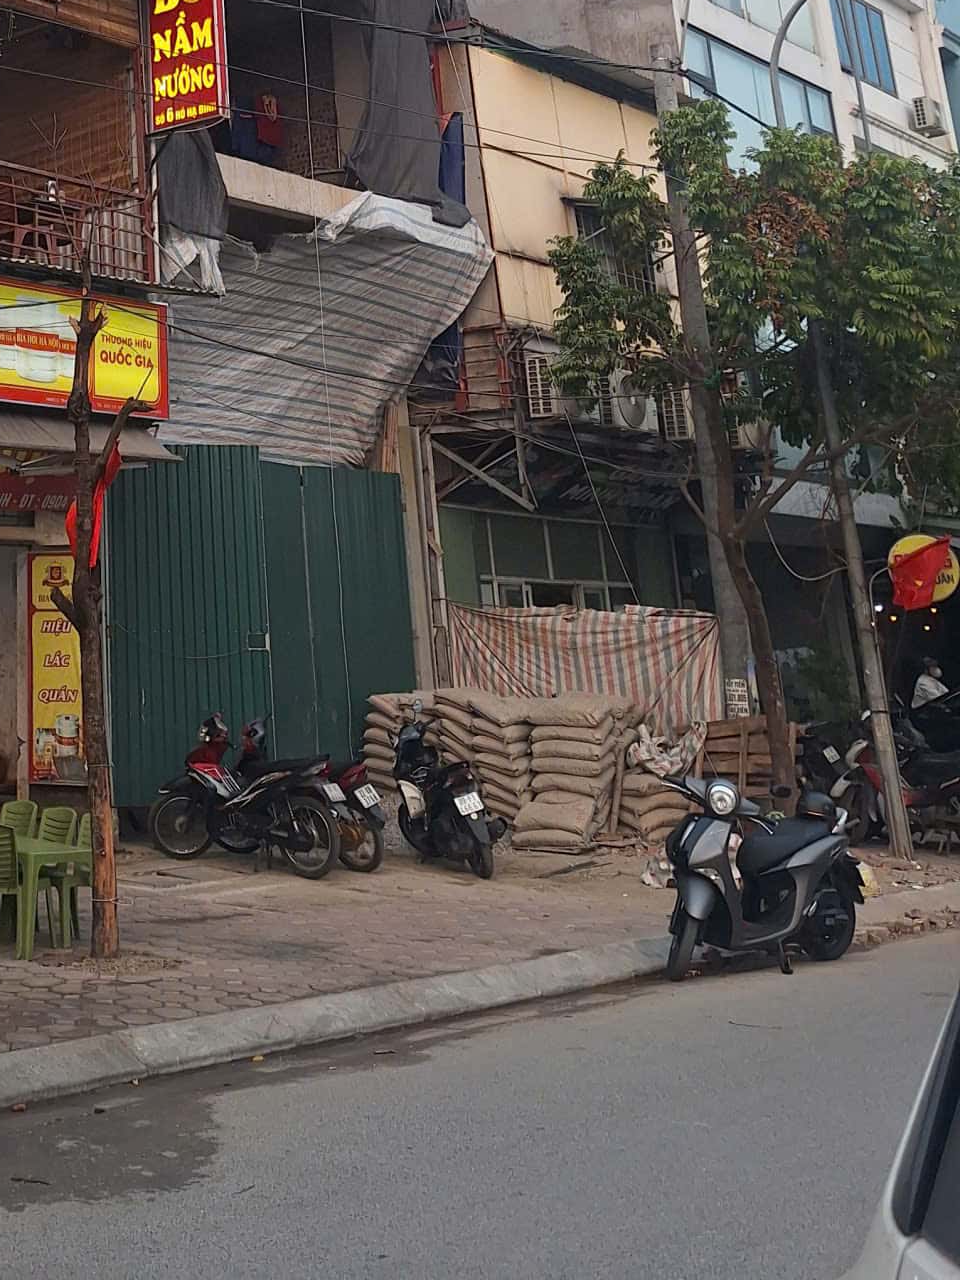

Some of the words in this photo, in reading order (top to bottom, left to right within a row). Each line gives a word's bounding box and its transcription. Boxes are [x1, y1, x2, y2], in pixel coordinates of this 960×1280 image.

[154, 63, 215, 102] NƯỚNG
[100, 347, 132, 366] QUỐC
[135, 355, 154, 369] GIA
[40, 619, 73, 636] HIỆU
[43, 652, 71, 668] LÁC
[38, 687, 79, 703] QUÁN
